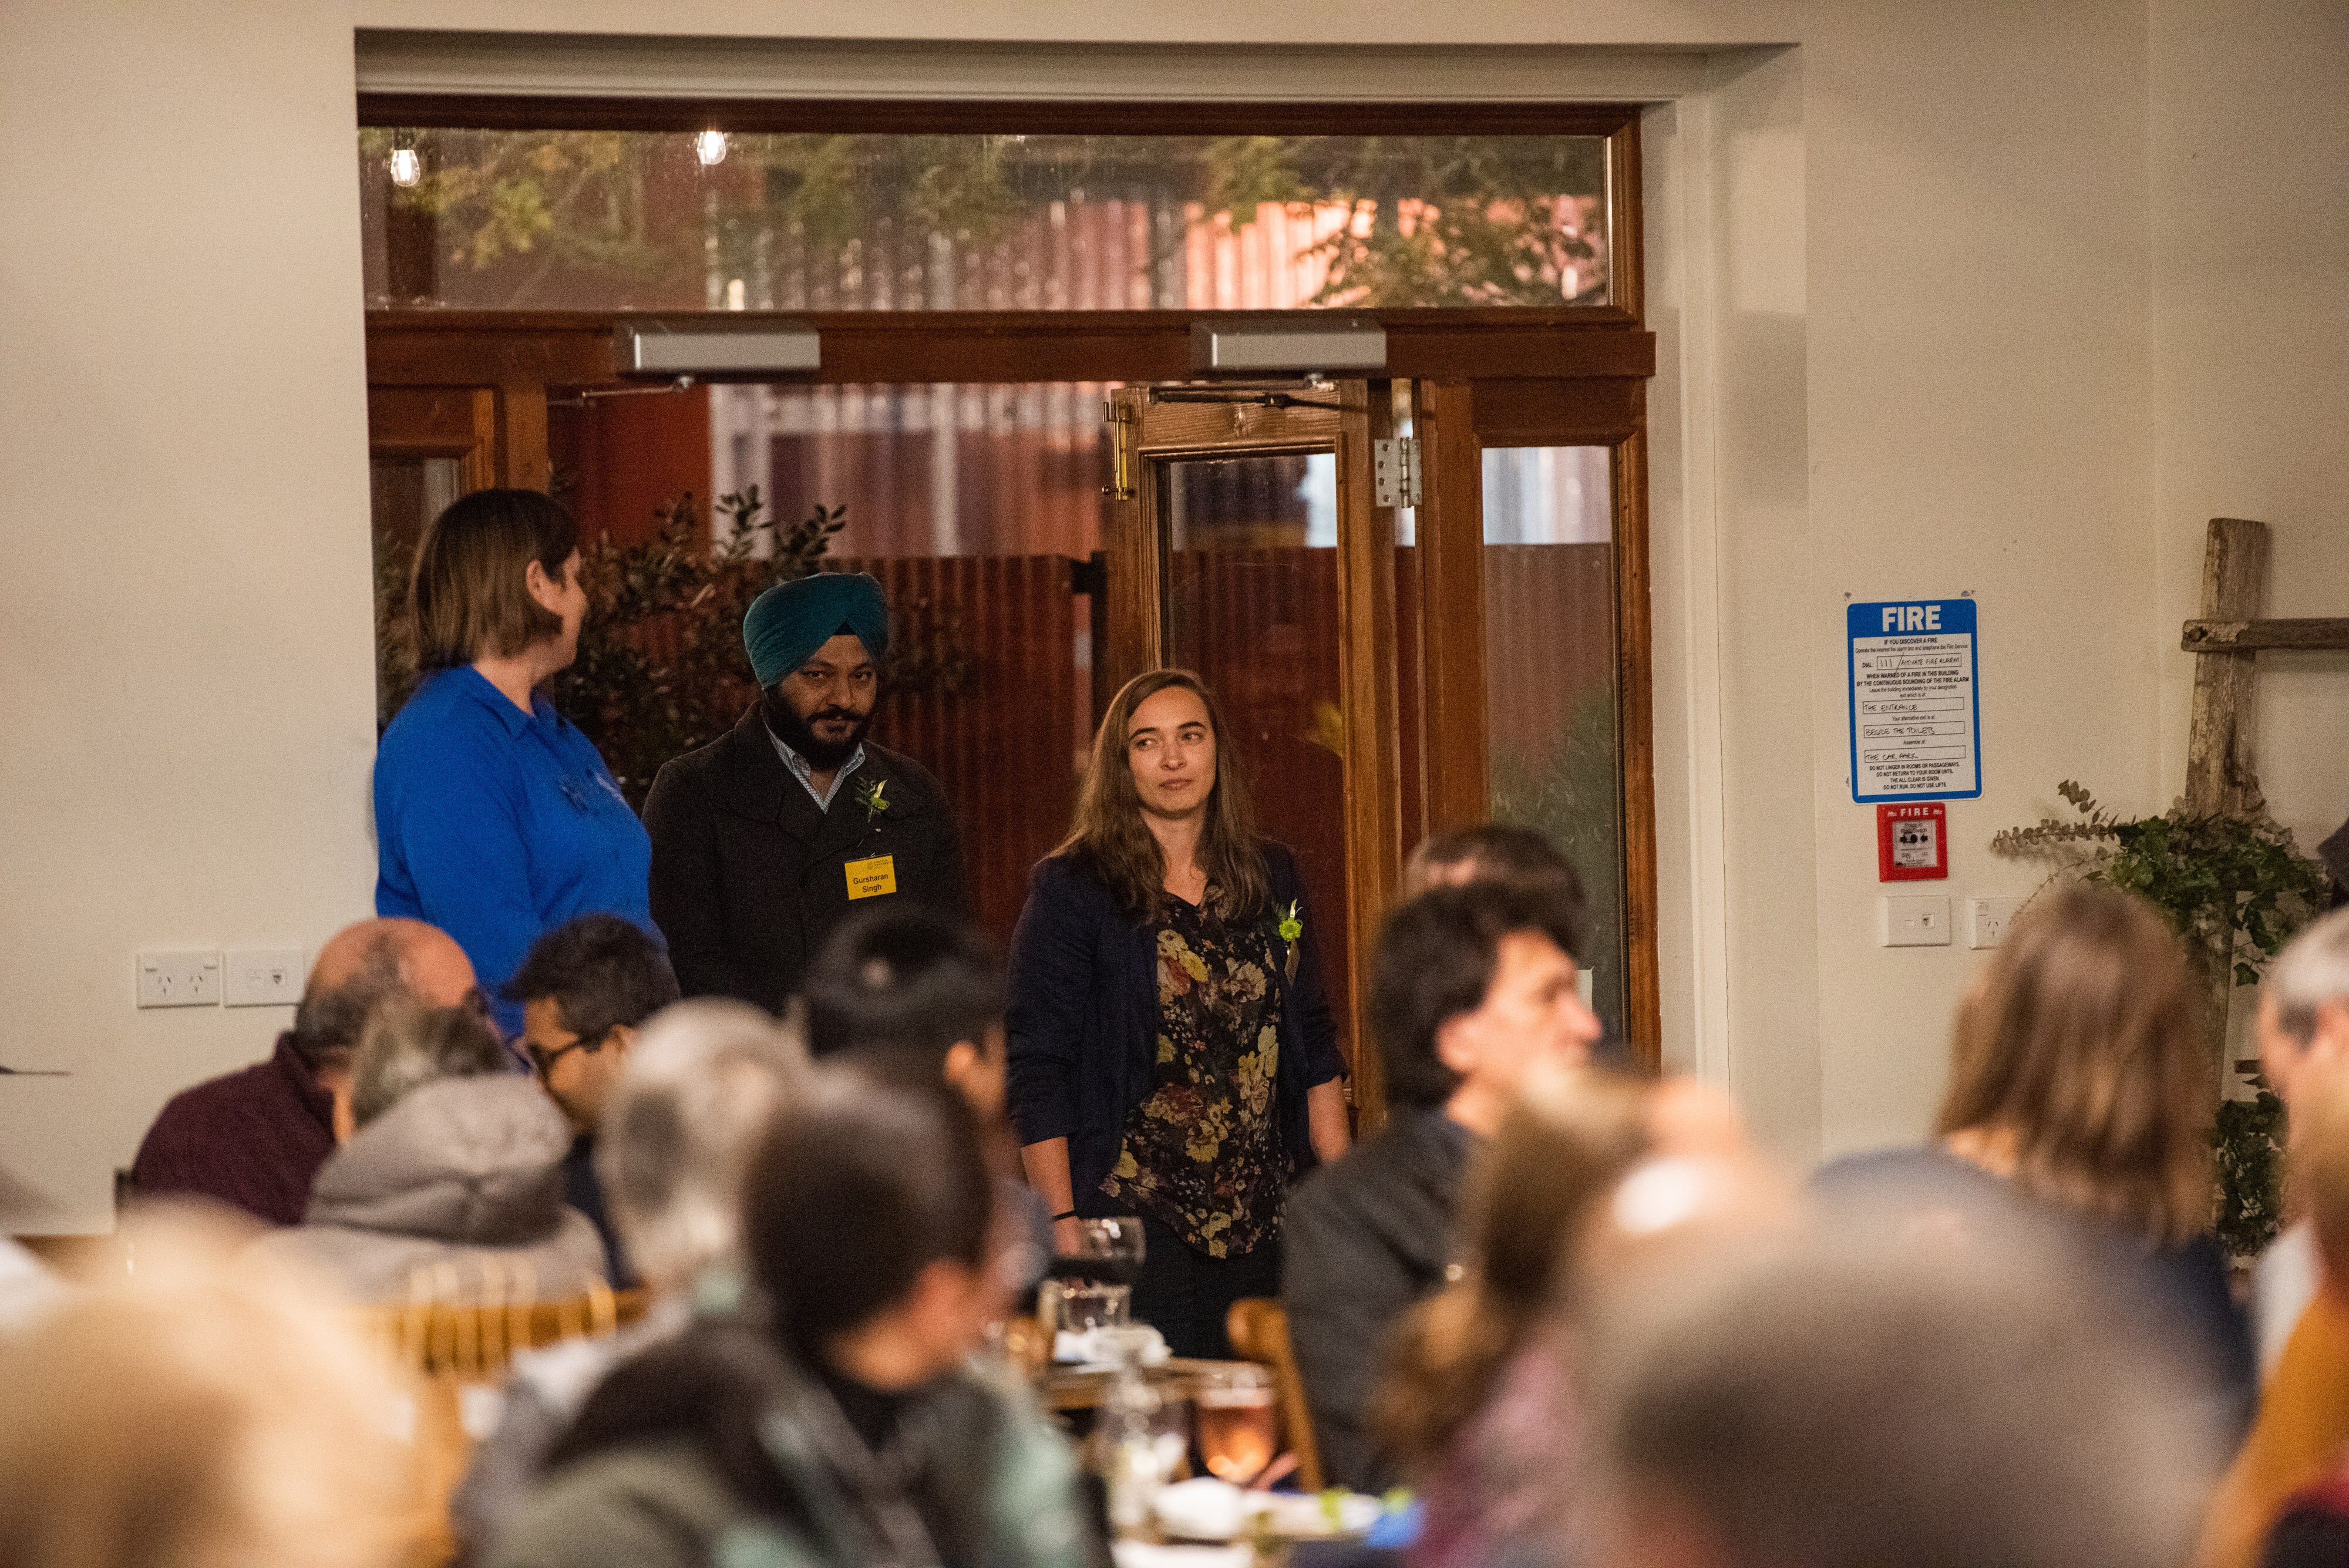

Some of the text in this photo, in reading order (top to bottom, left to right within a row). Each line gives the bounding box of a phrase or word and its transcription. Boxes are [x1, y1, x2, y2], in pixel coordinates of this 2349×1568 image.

[1882, 605, 1941, 632] FIRE
[1864, 704, 1917, 712] THE ENTRANCE
[1866, 728, 1890, 736] BESIDE
[1900, 807, 1929, 817] FIRE
[853, 874, 889, 884] Gursharan
[862, 884, 881, 893] Singh
